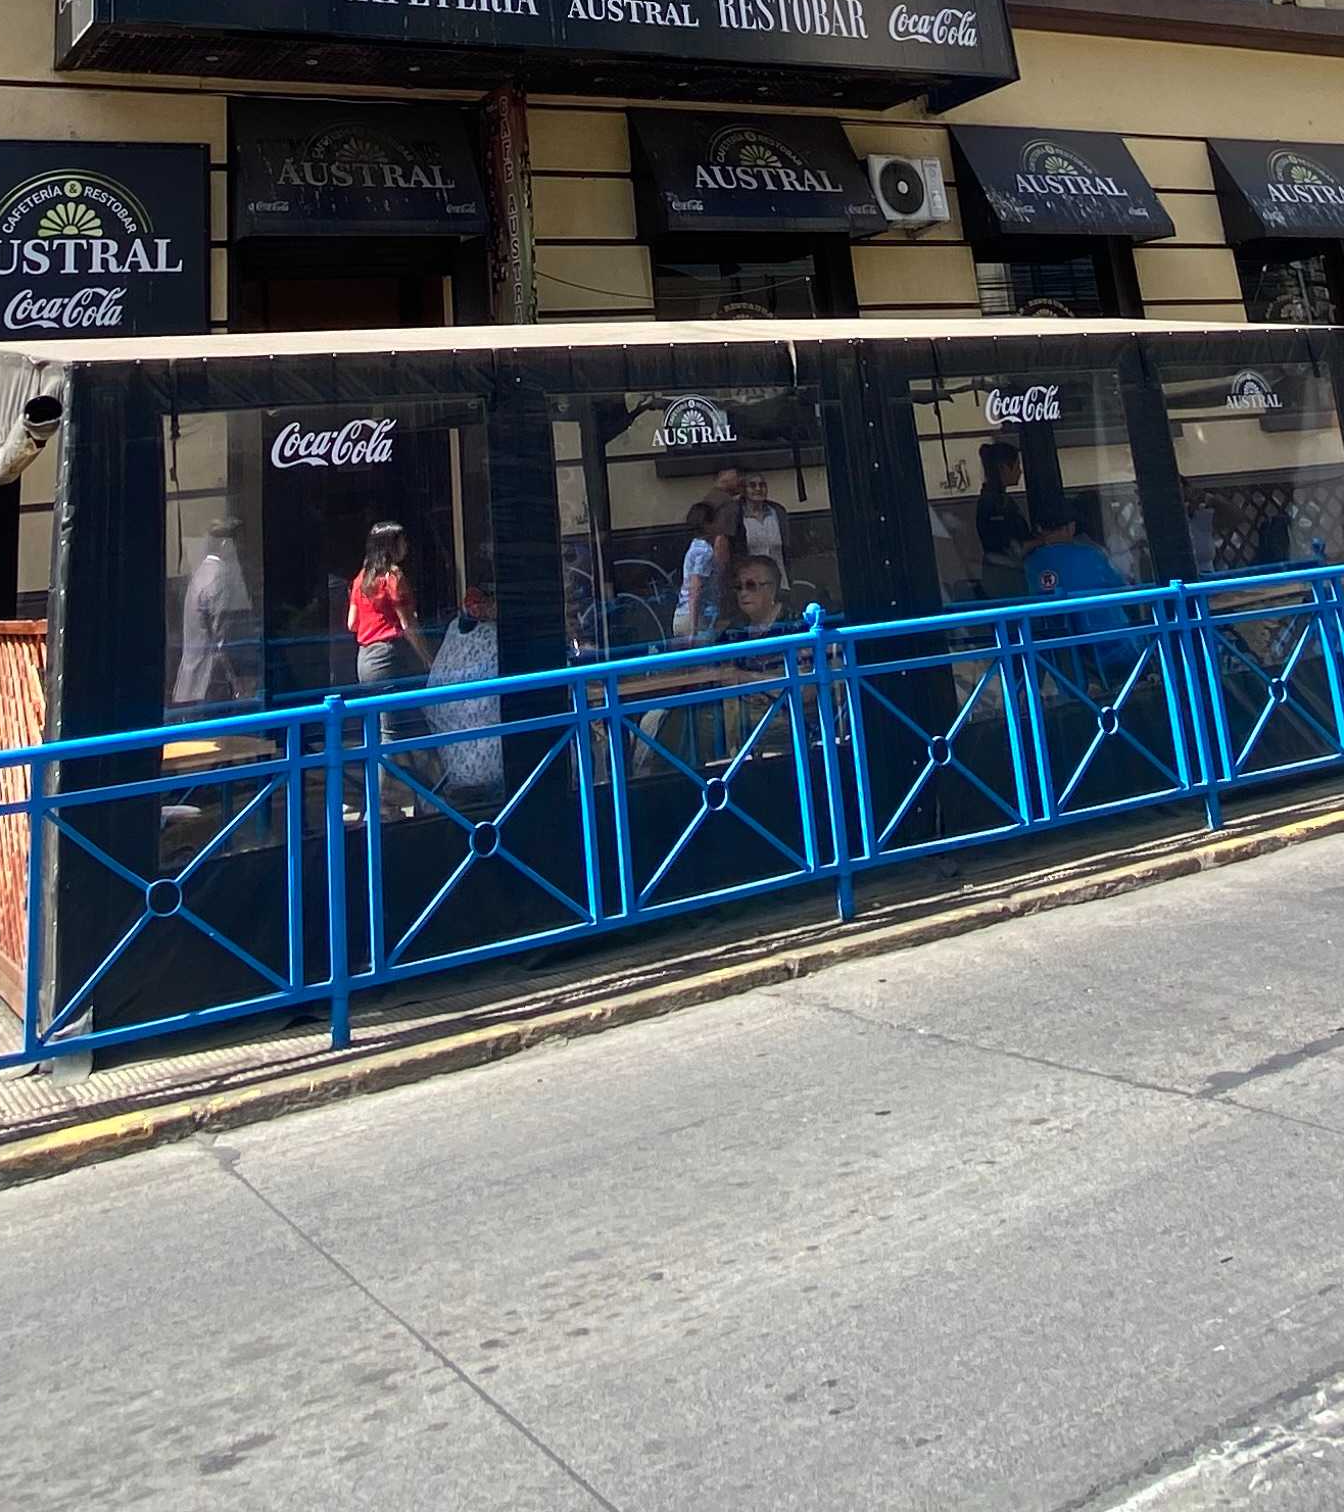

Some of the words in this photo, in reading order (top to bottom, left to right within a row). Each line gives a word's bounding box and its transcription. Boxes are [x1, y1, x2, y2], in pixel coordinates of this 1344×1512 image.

[889, 4, 977, 47] Coca-Cola
[276, 161, 456, 189] AUSTRAL
[695, 164, 843, 193] AUSTRAL
[1016, 174, 1128, 196] AUSTRAL
[2, 185, 62, 234] CAFETERÍA
[84, 186, 137, 234] RESTOBAR
[4, 287, 127, 329] Coca-Cola
[985, 385, 1060, 424] Coca-Cola
[1226, 393, 1283, 409] AUSTRAL
[271, 419, 397, 468] Coca-Cola
[652, 424, 737, 446] AUSTRAL
